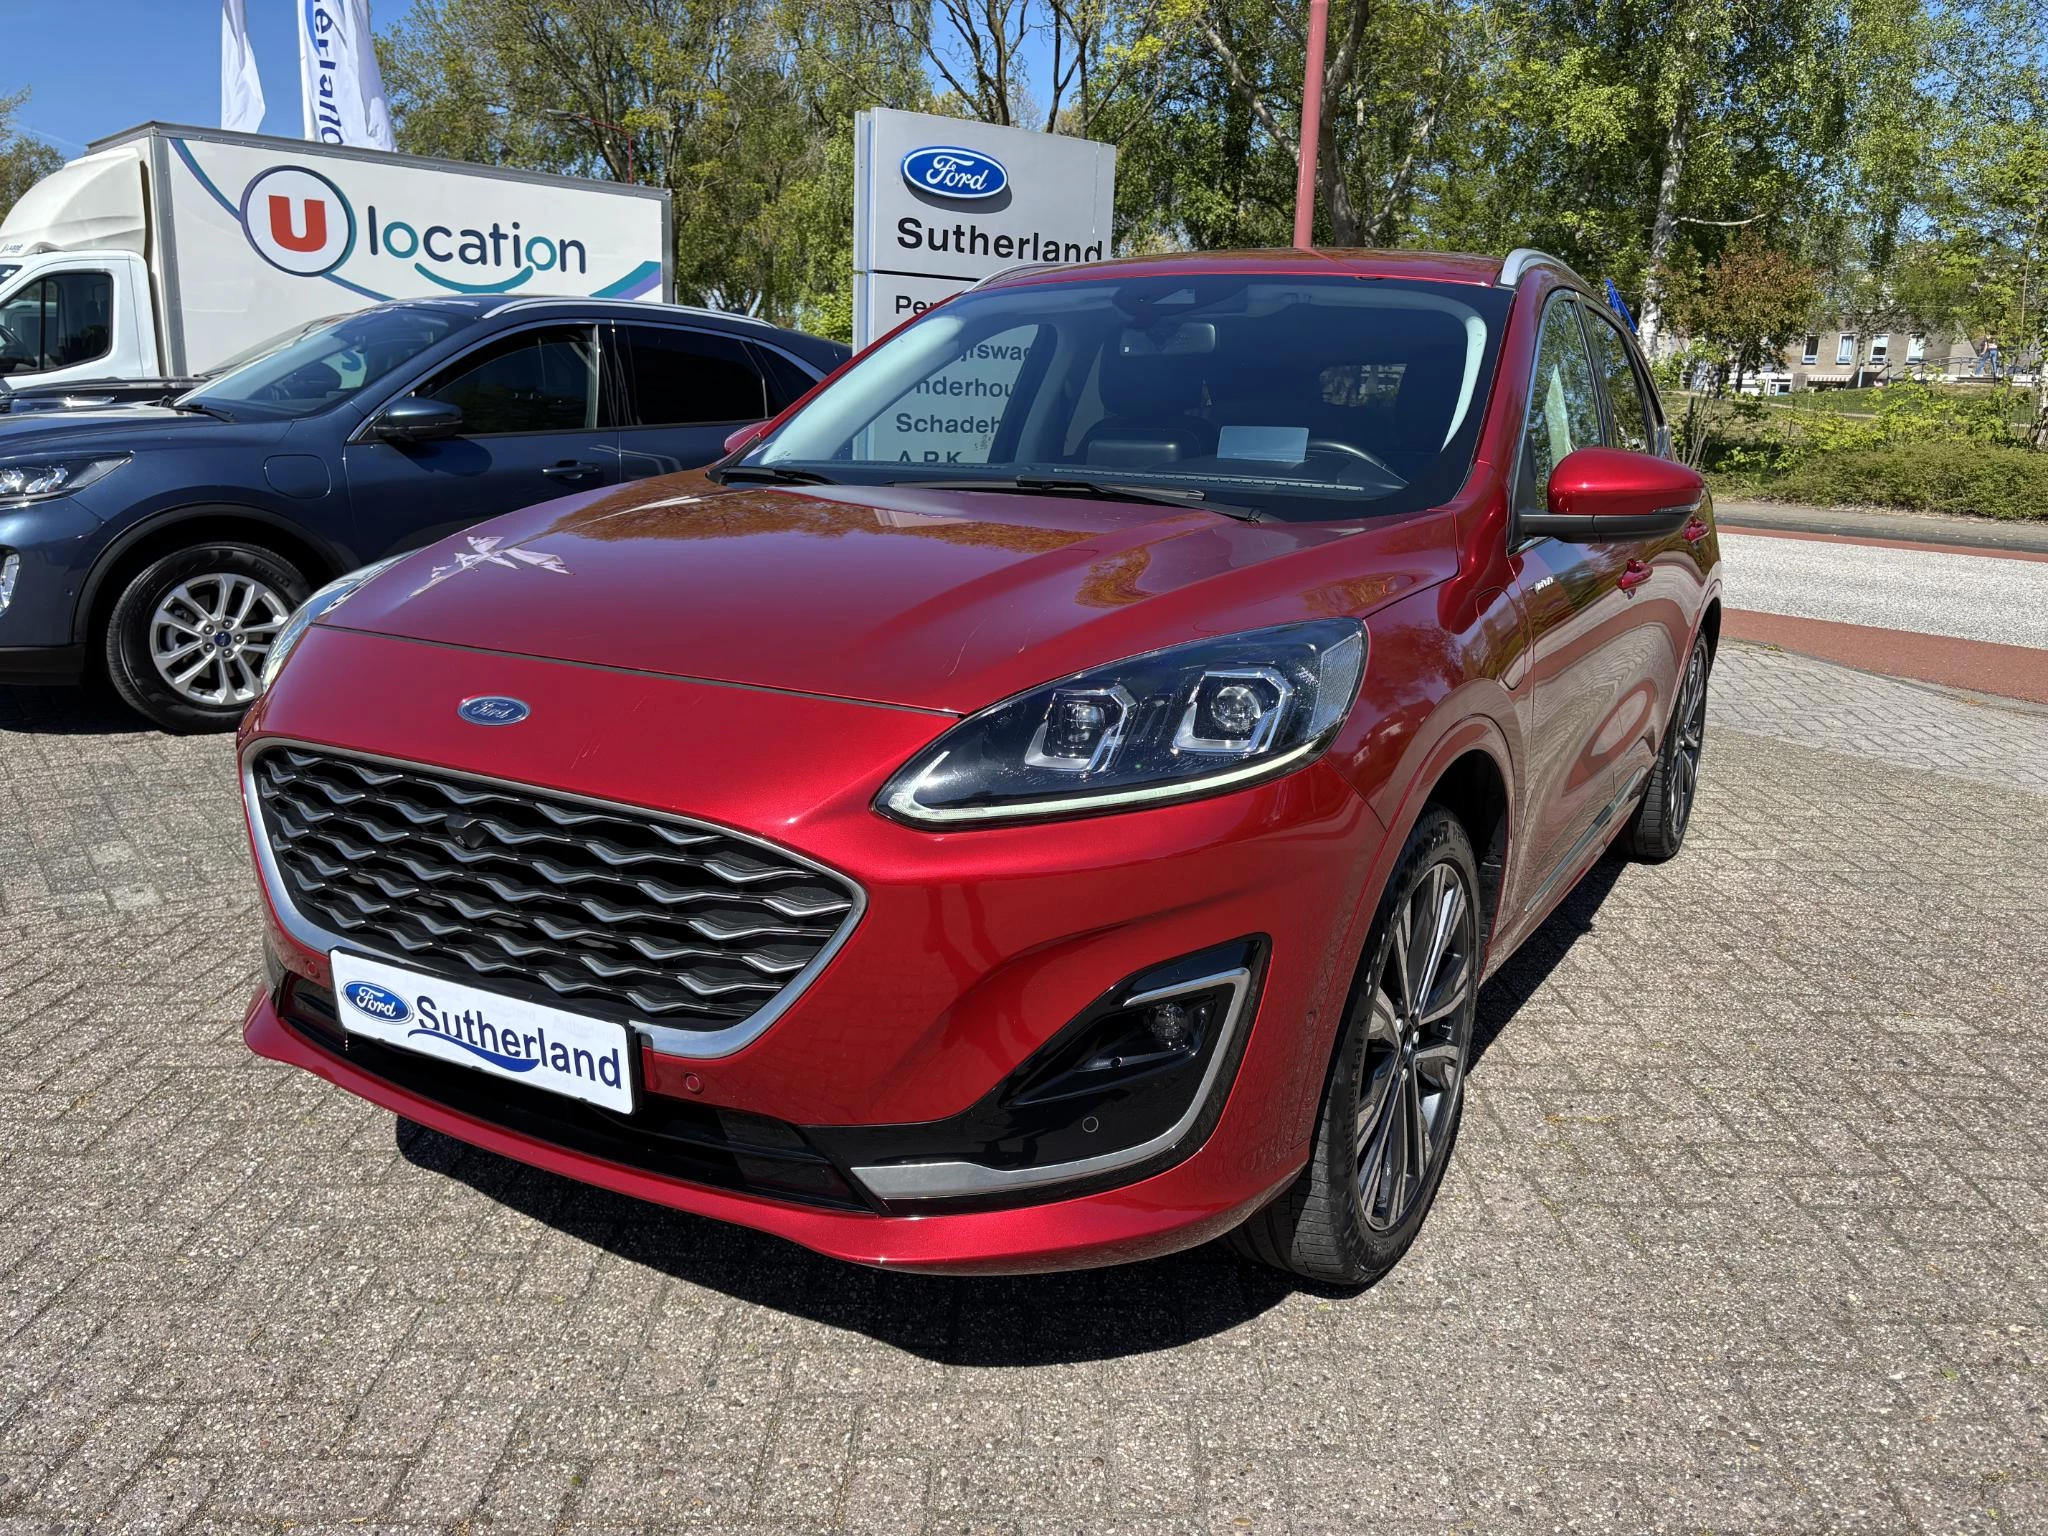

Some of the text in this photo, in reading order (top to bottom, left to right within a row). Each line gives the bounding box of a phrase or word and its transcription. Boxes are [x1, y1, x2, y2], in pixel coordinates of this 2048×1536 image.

[314, 0, 344, 145] erlan
[926, 155, 989, 191] Ford
[268, 194, 586, 274] U location
[897, 217, 1103, 262] Sutherland
[895, 295, 937, 315] Pe
[471, 700, 515, 719] Ford
[355, 986, 398, 1018] Ford
[416, 995, 623, 1090] Sutherland
